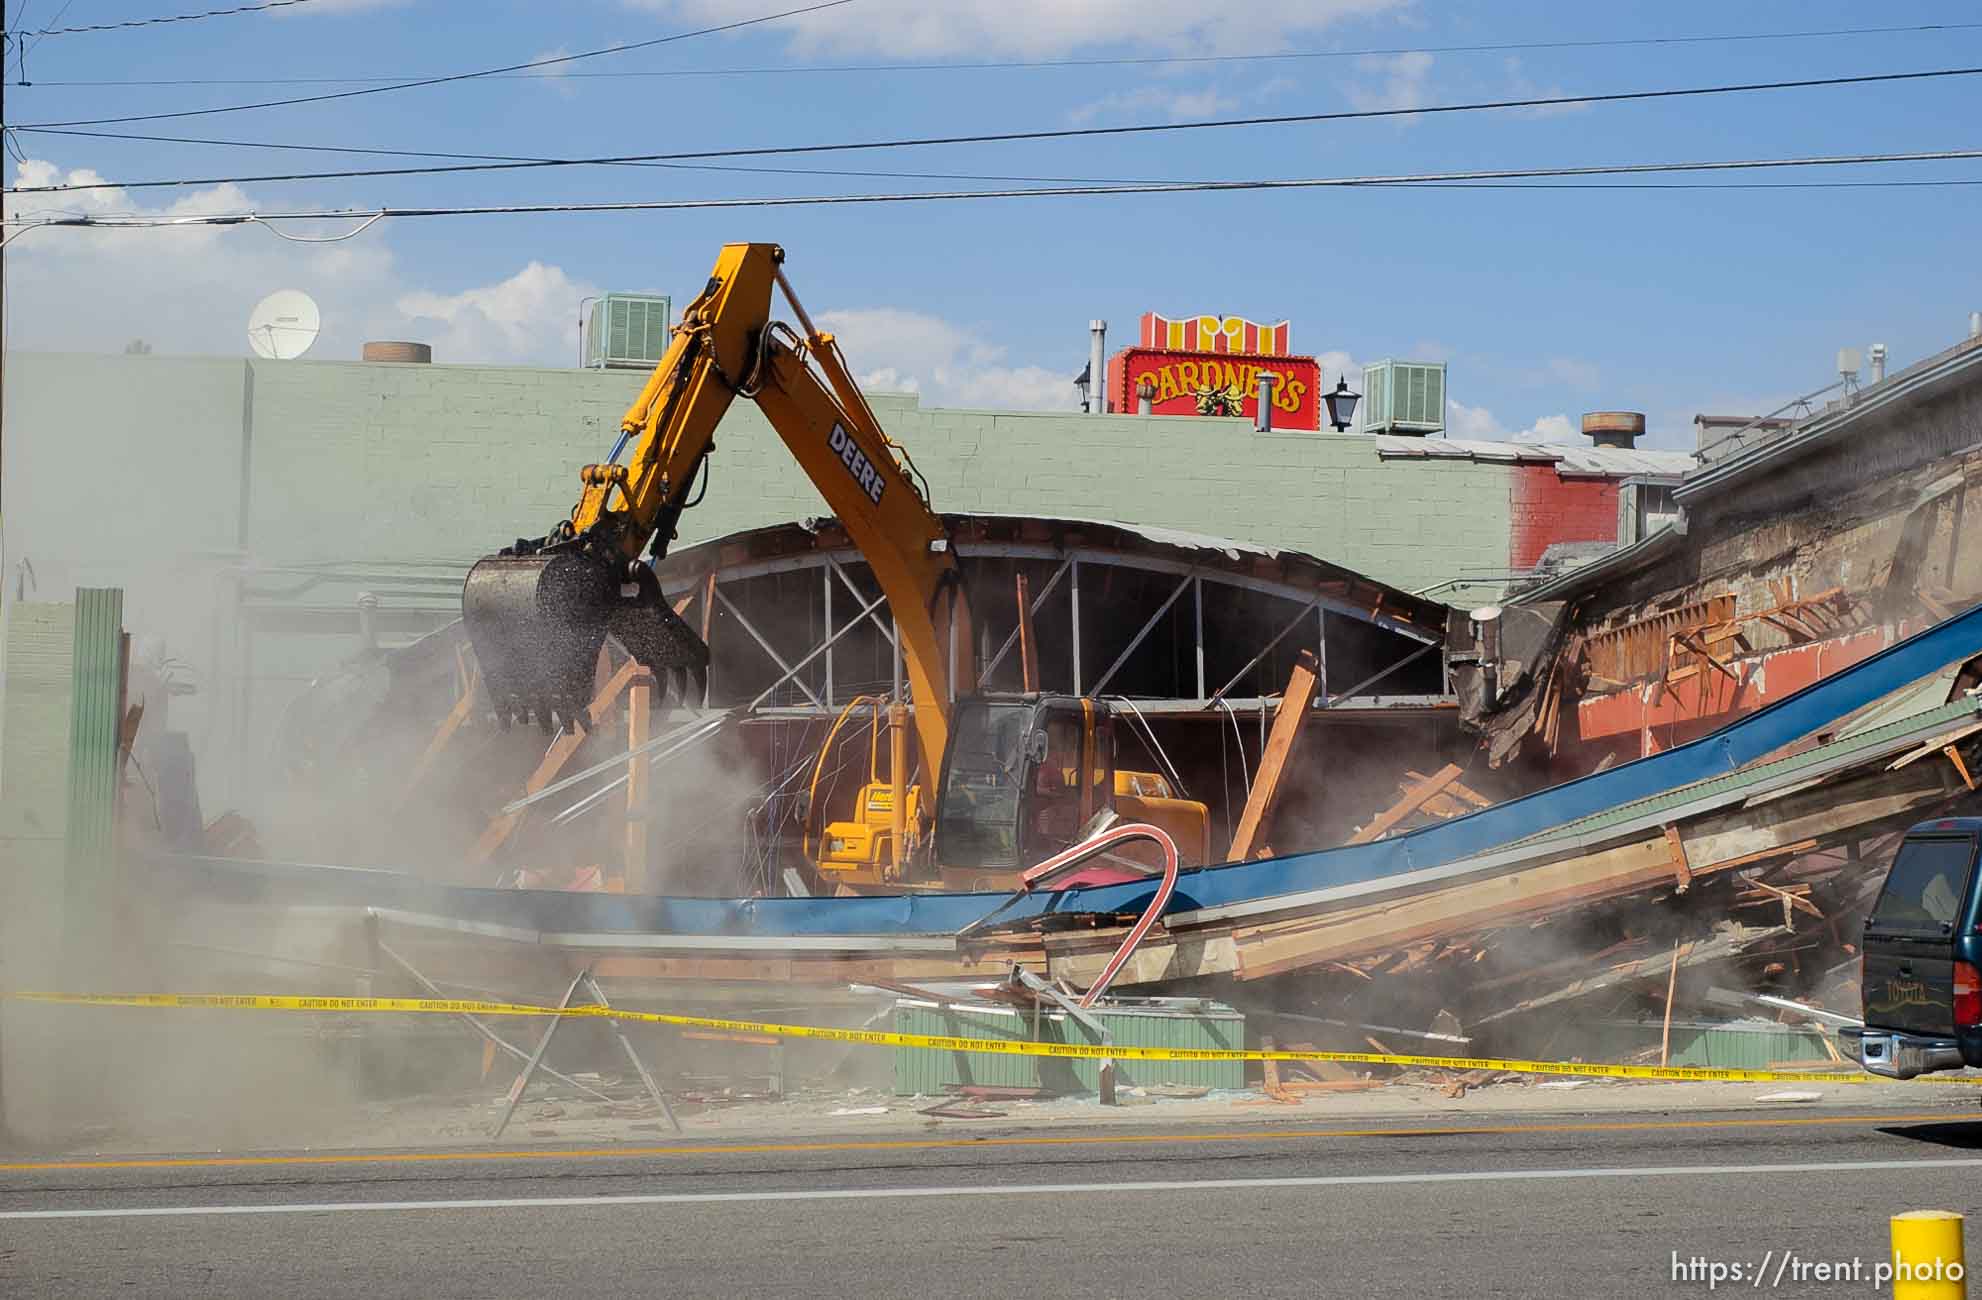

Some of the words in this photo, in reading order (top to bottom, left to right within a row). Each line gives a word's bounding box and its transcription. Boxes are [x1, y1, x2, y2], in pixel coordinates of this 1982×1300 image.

[828, 421, 886, 504] DEERE
[298, 1000, 327, 1008] CAUTION
[330, 1000, 339, 1008] DO
[341, 1000, 354, 1008] NOT
[355, 1000, 378, 1008] ENTER
[419, 1001, 448, 1009] CAUTION
[807, 1029, 836, 1039] CAUTION
[838, 1032, 848, 1040] DO
[850, 1032, 862, 1040] NOT
[863, 1033, 886, 1041] ENTER
[927, 1039, 957, 1048] CAUTION
[959, 1040, 968, 1048] DO
[985, 1042, 1006, 1050] ENTER
[1049, 1046, 1078, 1054] CAUTION
[1079, 1048, 1088, 1056] DO
[1091, 1048, 1104, 1056] NOT
[1106, 1048, 1127, 1056] ENTER
[1168, 1050, 1198, 1058] CAUTION
[1411, 1058, 1440, 1066] CAUTION
[1467, 1060, 1488, 1068] ENTER
[1530, 1064, 1560, 1072] CAUTION
[1586, 1066, 1608, 1074] ENTER
[1694, 1070, 1706, 1078] NOT
[1771, 1072, 1801, 1080] CAUTION
